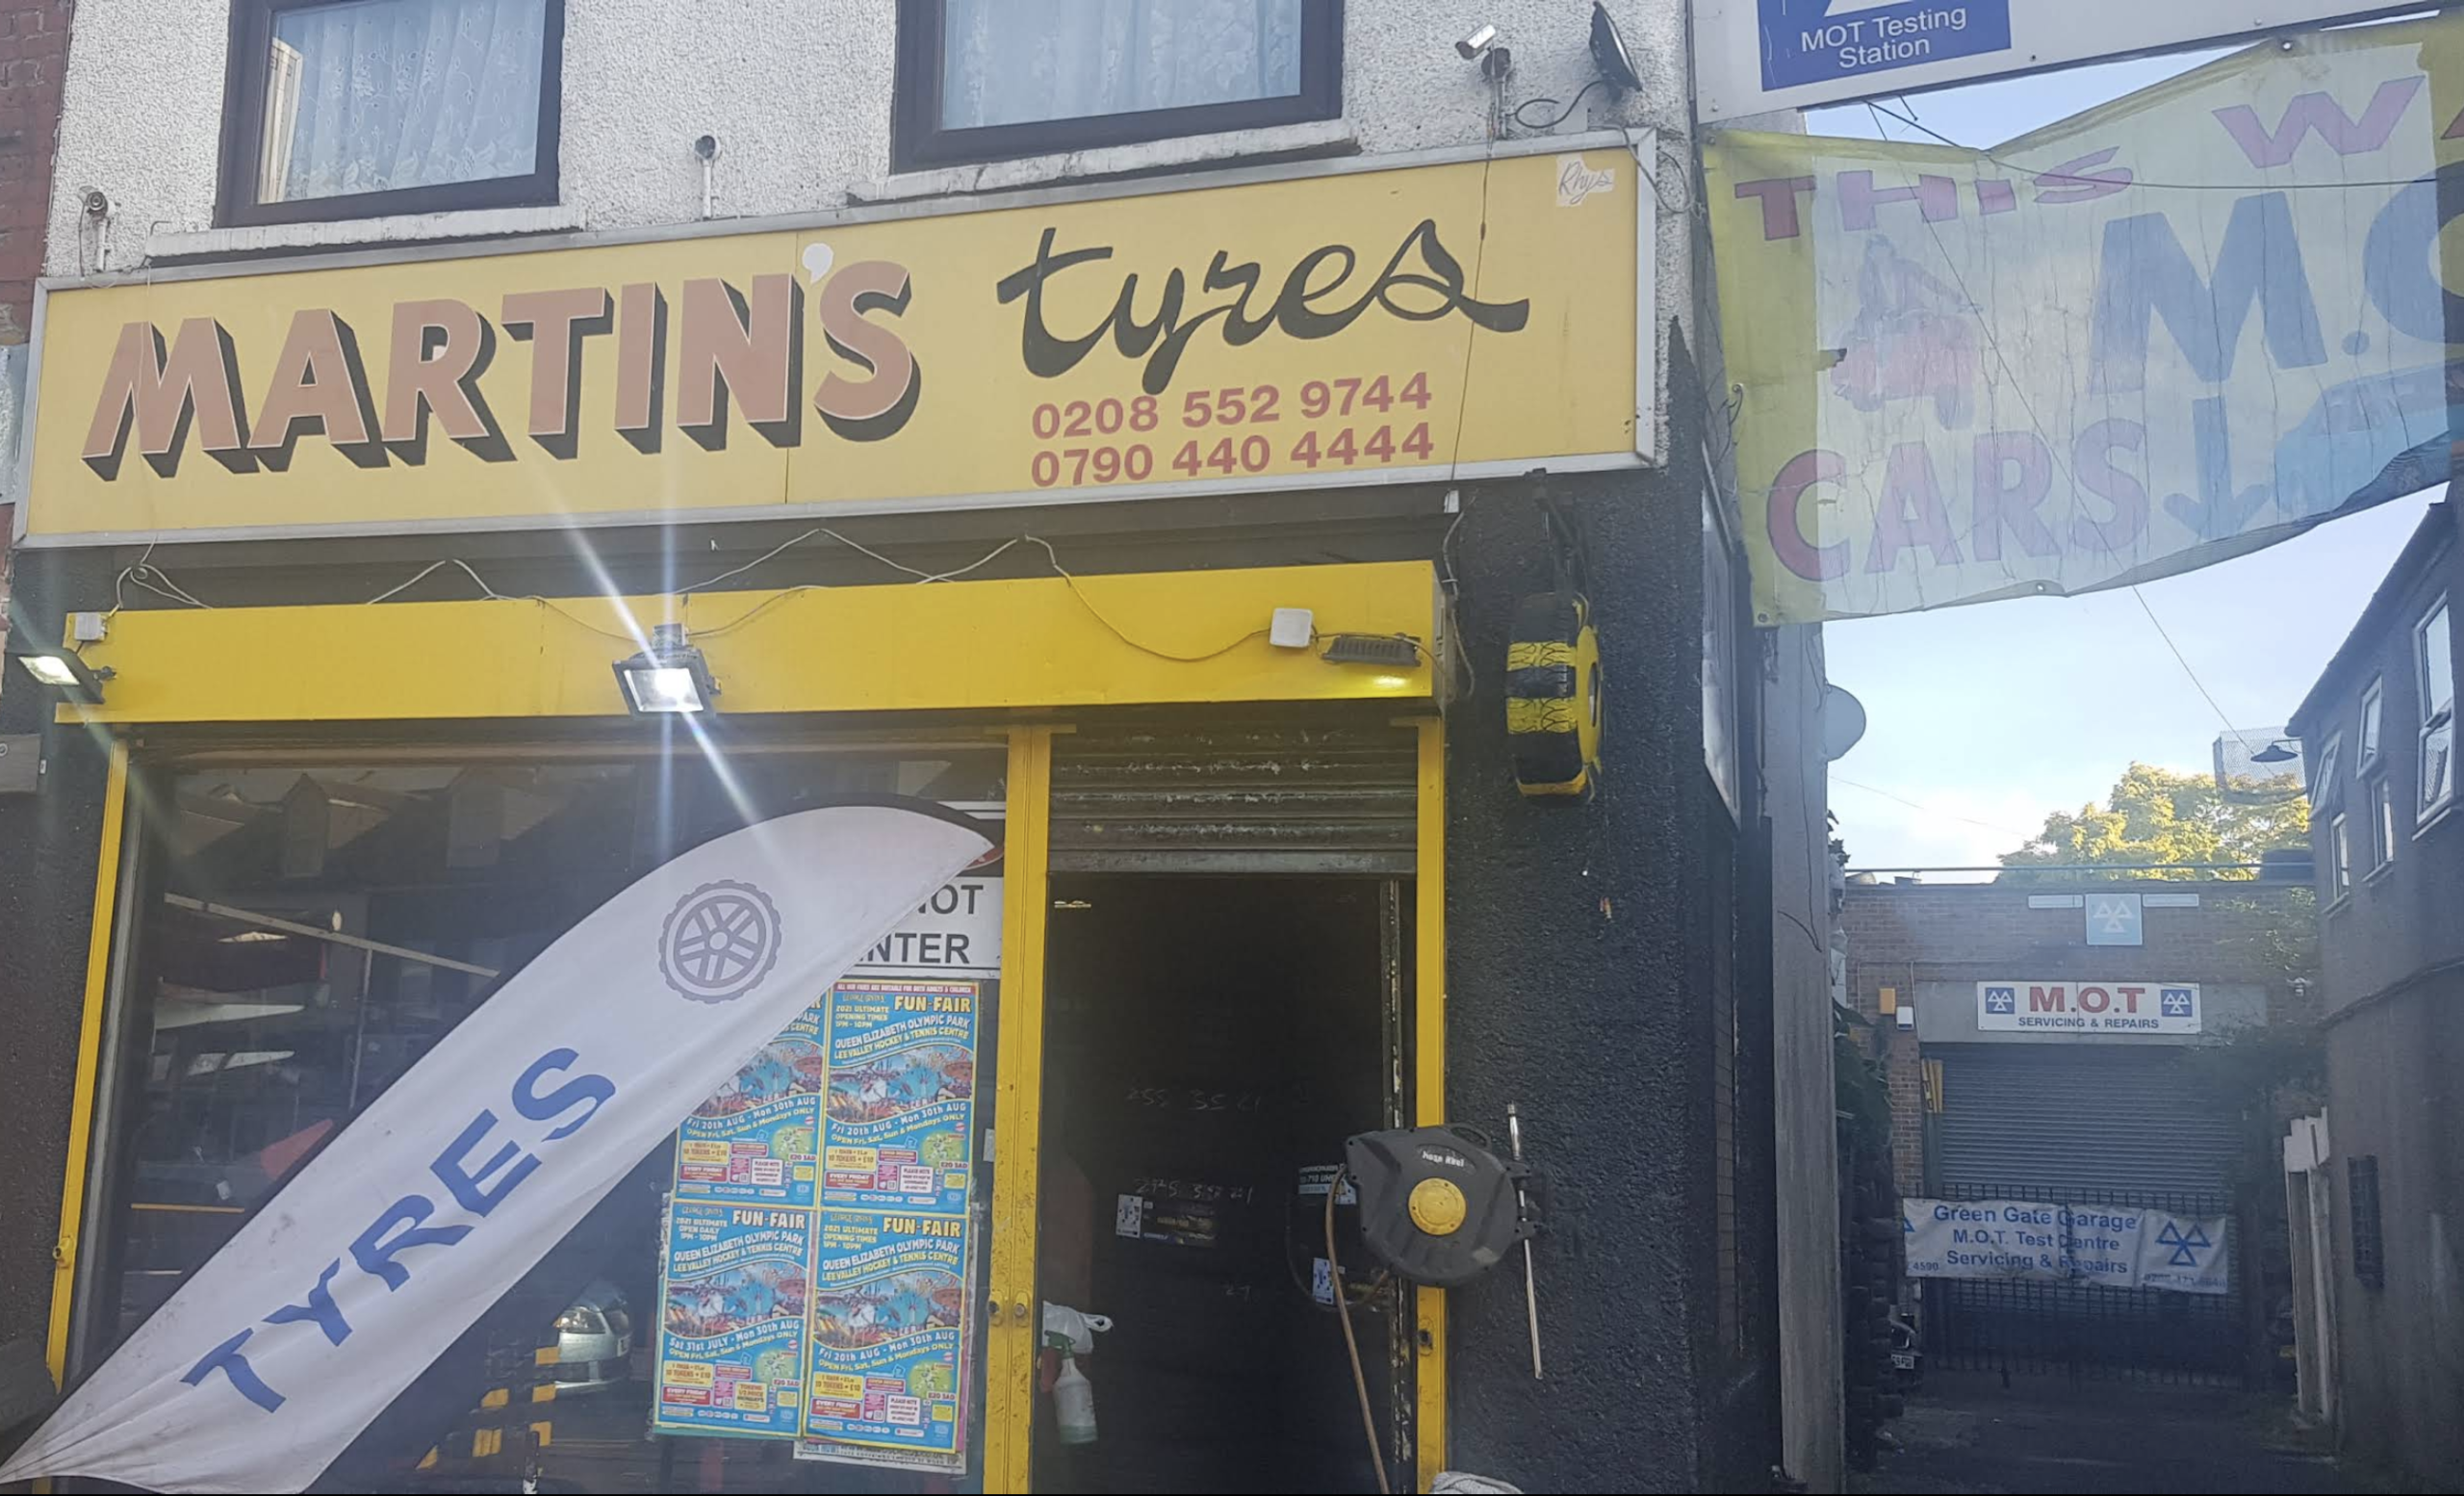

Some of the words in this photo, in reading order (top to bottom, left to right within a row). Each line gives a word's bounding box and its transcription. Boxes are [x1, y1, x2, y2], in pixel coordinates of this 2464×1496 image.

[1802, 21, 1865, 52] MOT
[1872, 8, 1967, 39] Testing
[1838, 39, 1930, 68] Station
[1734, 146, 2133, 241] THIS
[82, 243, 921, 482] MARTIN'S
[996, 218, 1530, 396] tyres
[1031, 395, 1159, 440] 0208
[1182, 384, 1280, 428] 552
[1299, 372, 1432, 420] 9744
[1031, 443, 1153, 488] 0790
[1171, 434, 1271, 477] 440
[1290, 422, 1434, 469] 4444
[1765, 418, 2149, 581] CARS
[918, 884, 984, 915] OT
[860, 932, 970, 965] NTER
[893, 995, 971, 1012] FUN-FAIR
[2029, 986, 2145, 1014] M.O.T
[835, 1036, 862, 1048] QUEEN
[863, 1021, 907, 1044] ELIZABETH
[907, 1015, 943, 1030] OLYMPIC
[946, 1015, 970, 1029] PARK
[938, 1027, 969, 1039] CENTRE
[2018, 1017, 2086, 1028] SERVICING
[2091, 1019, 2099, 1028] &
[2104, 1019, 2159, 1029] REPAIRS
[686, 1118, 700, 1127] Fri
[702, 1120, 723, 1129] 20th
[727, 1115, 746, 1127] AUG
[753, 1108, 771, 1119] Mon
[774, 1099, 794, 1112] 30th
[797, 1096, 816, 1106] AUG
[793, 1107, 815, 1116] ONLY
[832, 1122, 844, 1133] Fri
[847, 1124, 869, 1135] 20th
[873, 1122, 892, 1134] AUG
[900, 1112, 920, 1123] Mon
[922, 1105, 943, 1118] 30th
[946, 1102, 966, 1112] AUG
[179, 1047, 617, 1414] TYRES
[732, 1210, 805, 1228] FUN-FAIR
[883, 1217, 961, 1237] FUN-FAIR
[1934, 1205, 1996, 1223] Green
[2003, 1206, 2052, 1225] Gate
[674, 1250, 701, 1261] QUEEN
[703, 1236, 743, 1257] ELIZABETH
[744, 1230, 780, 1245] OLYMPIC
[782, 1231, 805, 1246] PARK
[774, 1244, 803, 1256] CENTRE
[823, 1259, 850, 1271] QUEEN
[852, 1245, 895, 1266] ELIZABETH
[896, 1238, 934, 1253] OLYMPIC
[936, 1239, 961, 1254] PARK
[2015, 1231, 2053, 1249] Test
[928, 1251, 959, 1265] CENTRE
[1946, 1251, 2034, 1271] Servicing
[2040, 1253, 2052, 1269] &
[669, 1338, 683, 1350] Sat
[686, 1340, 705, 1351] 31st
[708, 1336, 729, 1350] JULY
[735, 1330, 756, 1341] Mon
[757, 1324, 778, 1335] 30th
[781, 1320, 799, 1329] AUG
[818, 1348, 832, 1359] Fri
[834, 1350, 856, 1361] 20th
[860, 1347, 881, 1360] AUG
[888, 1340, 909, 1352] Mon
[911, 1332, 933, 1346] 30th
[935, 1331, 955, 1341] AUG
